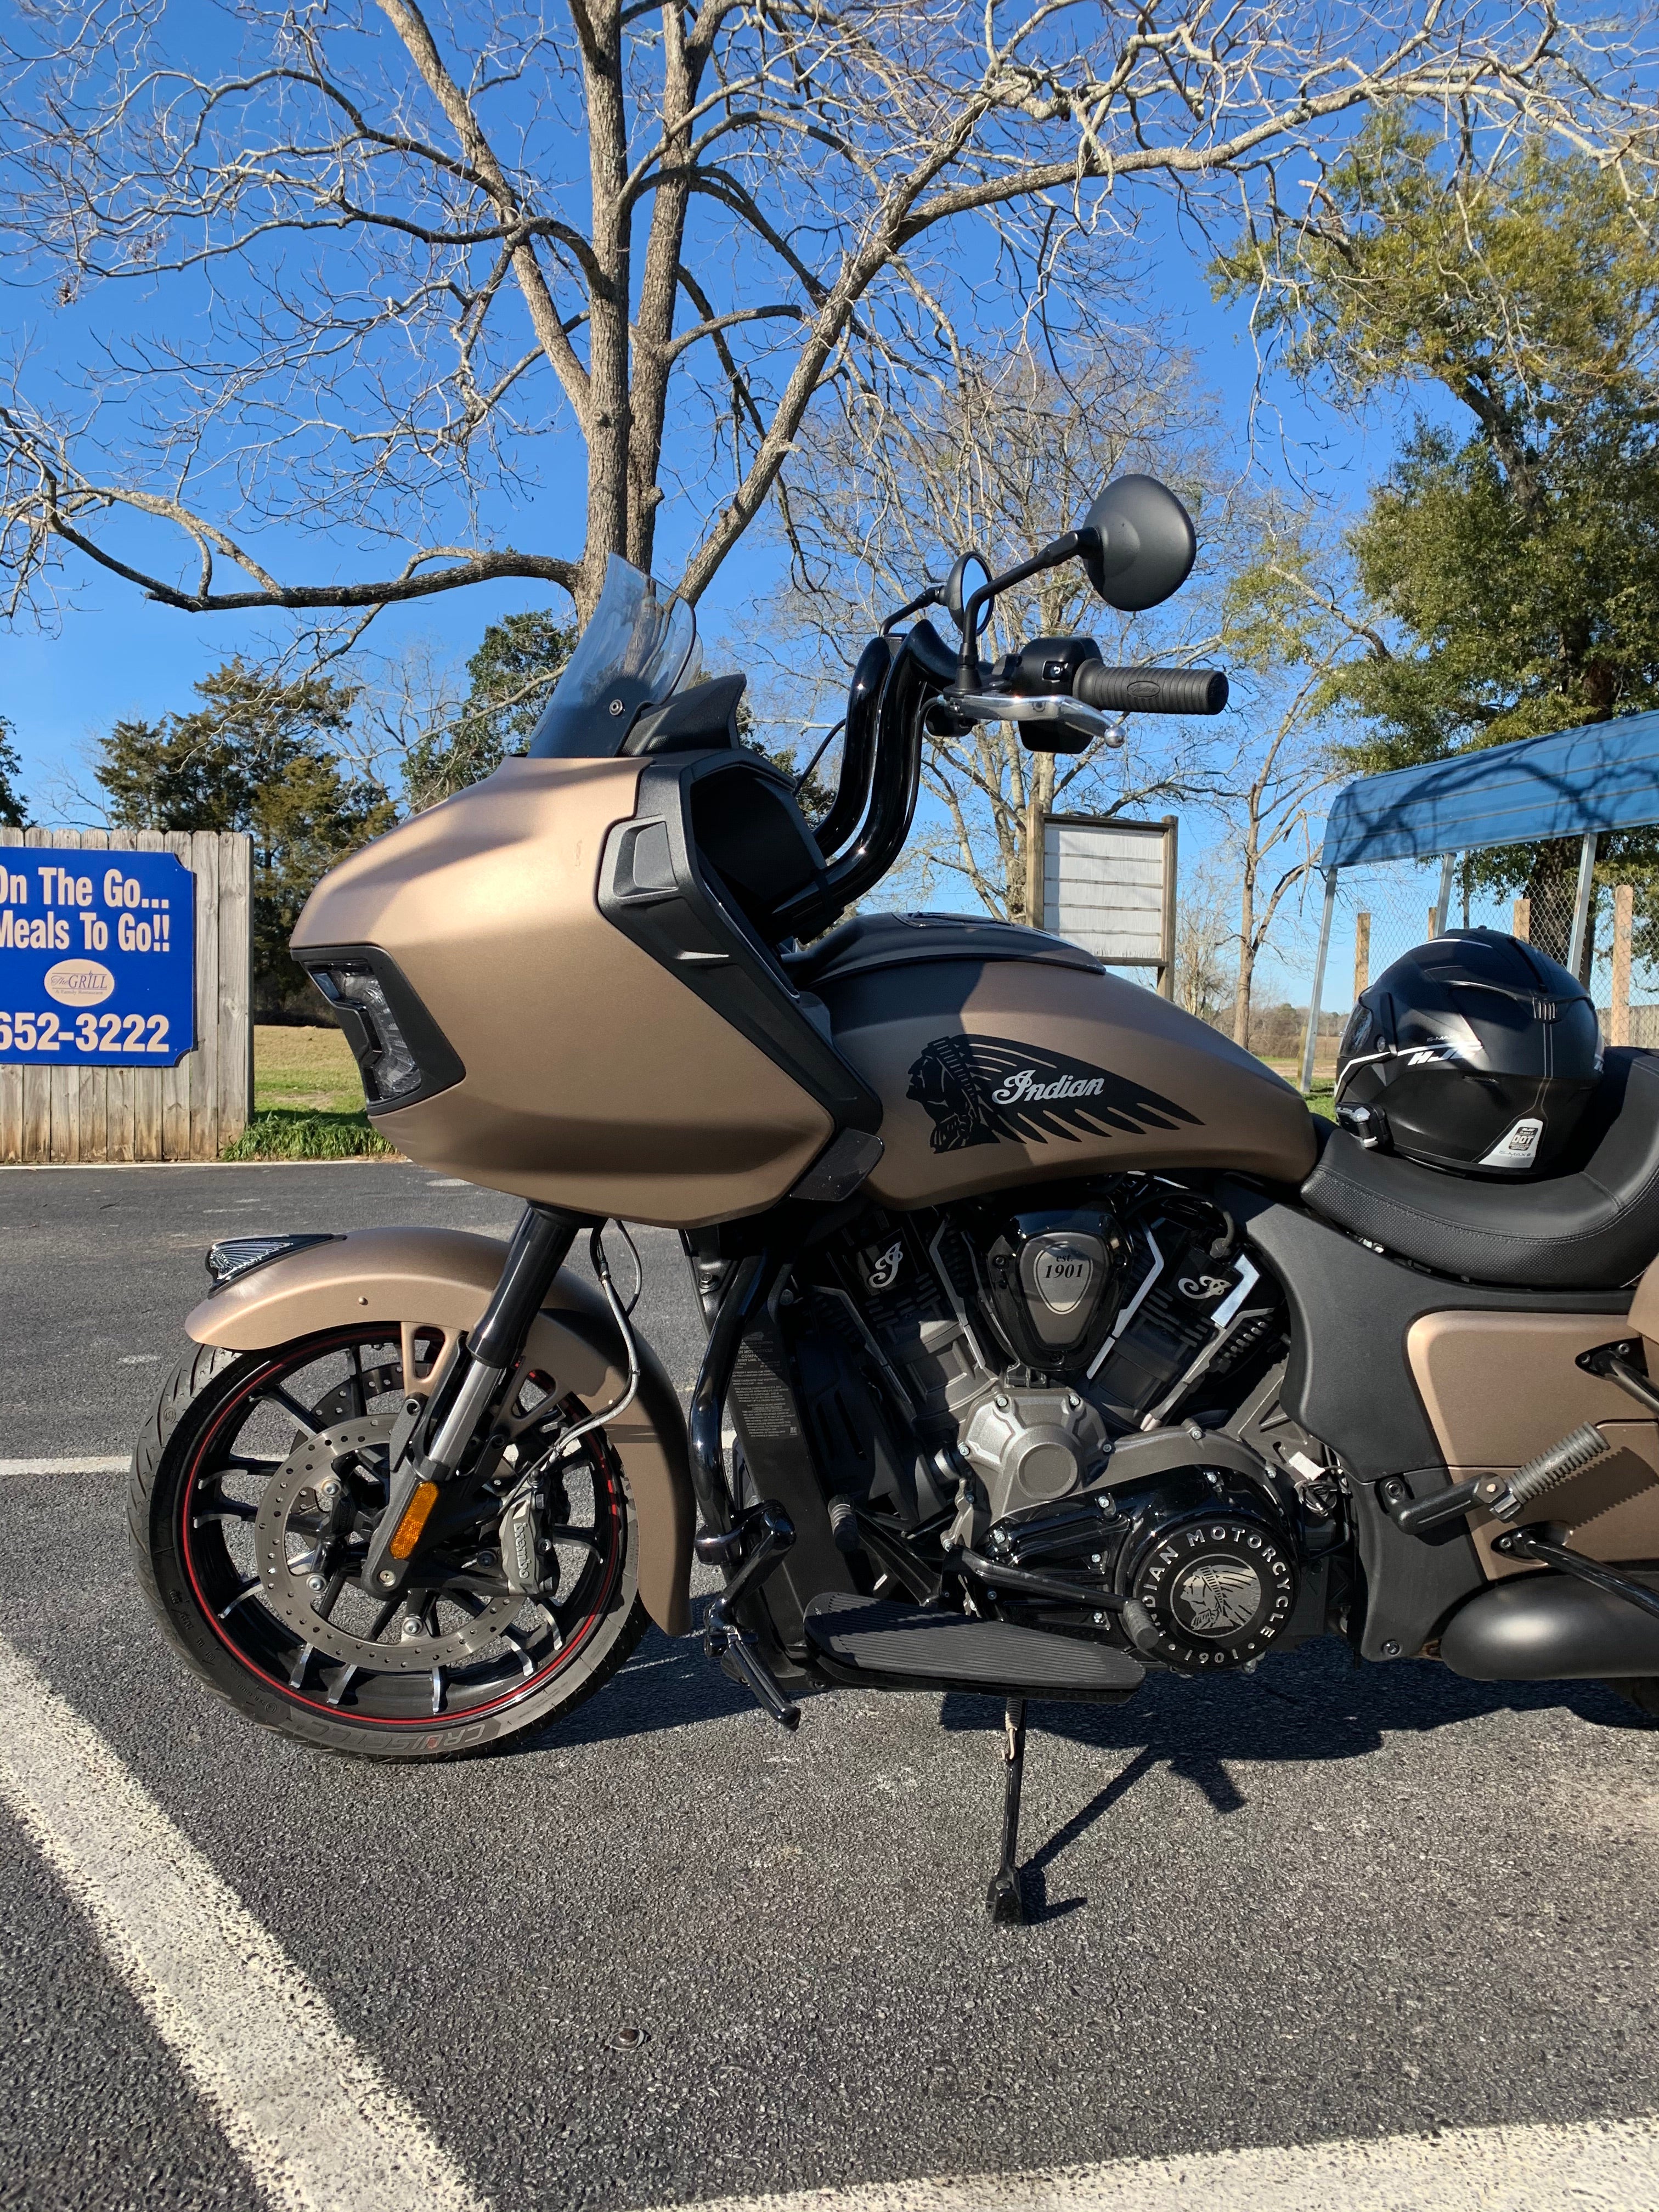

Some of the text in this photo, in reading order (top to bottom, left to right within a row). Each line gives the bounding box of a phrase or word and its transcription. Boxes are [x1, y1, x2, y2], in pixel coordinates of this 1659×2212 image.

[38, 867, 92, 907] The
[104, 868, 169, 909] Go...
[80, 912, 108, 951] To
[118, 912, 170, 952] Go!!
[69, 970, 107, 989] GRILL
[0, 1012, 169, 1052] 652-3222
[991, 1070, 1105, 1105] Indian
[1512, 1135, 1534, 1144] DOT
[1043, 1263, 1083, 1278] 1901
[514, 1522, 531, 1579] brembo
[1142, 1526, 1291, 1638] DIAN MOTORCYCLE
[1183, 1649, 1239, 1664] 1901
